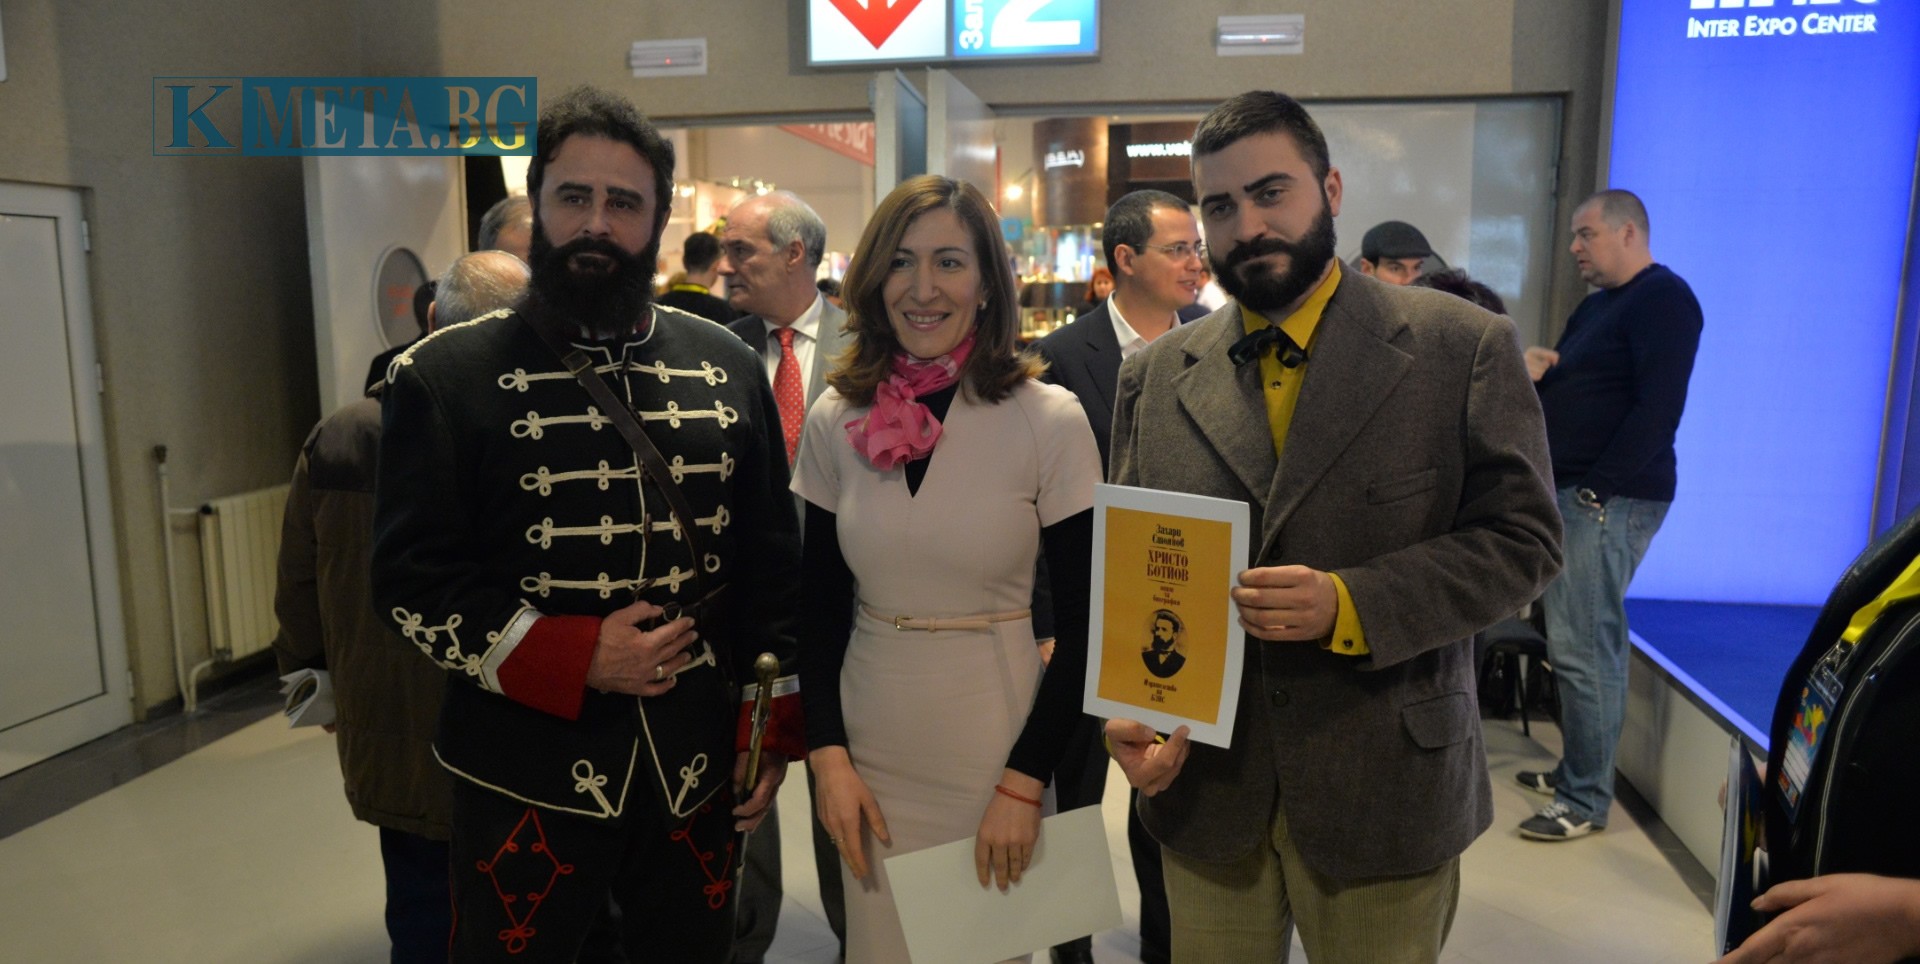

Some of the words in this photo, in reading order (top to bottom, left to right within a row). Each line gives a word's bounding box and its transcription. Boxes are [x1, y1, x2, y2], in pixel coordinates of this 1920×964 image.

[1687, 17, 1740, 38] INTER
[1744, 15, 1798, 36] EXPO
[1802, 13, 1877, 35] CENTER
[1147, 549, 1189, 567] ХРИСТО
